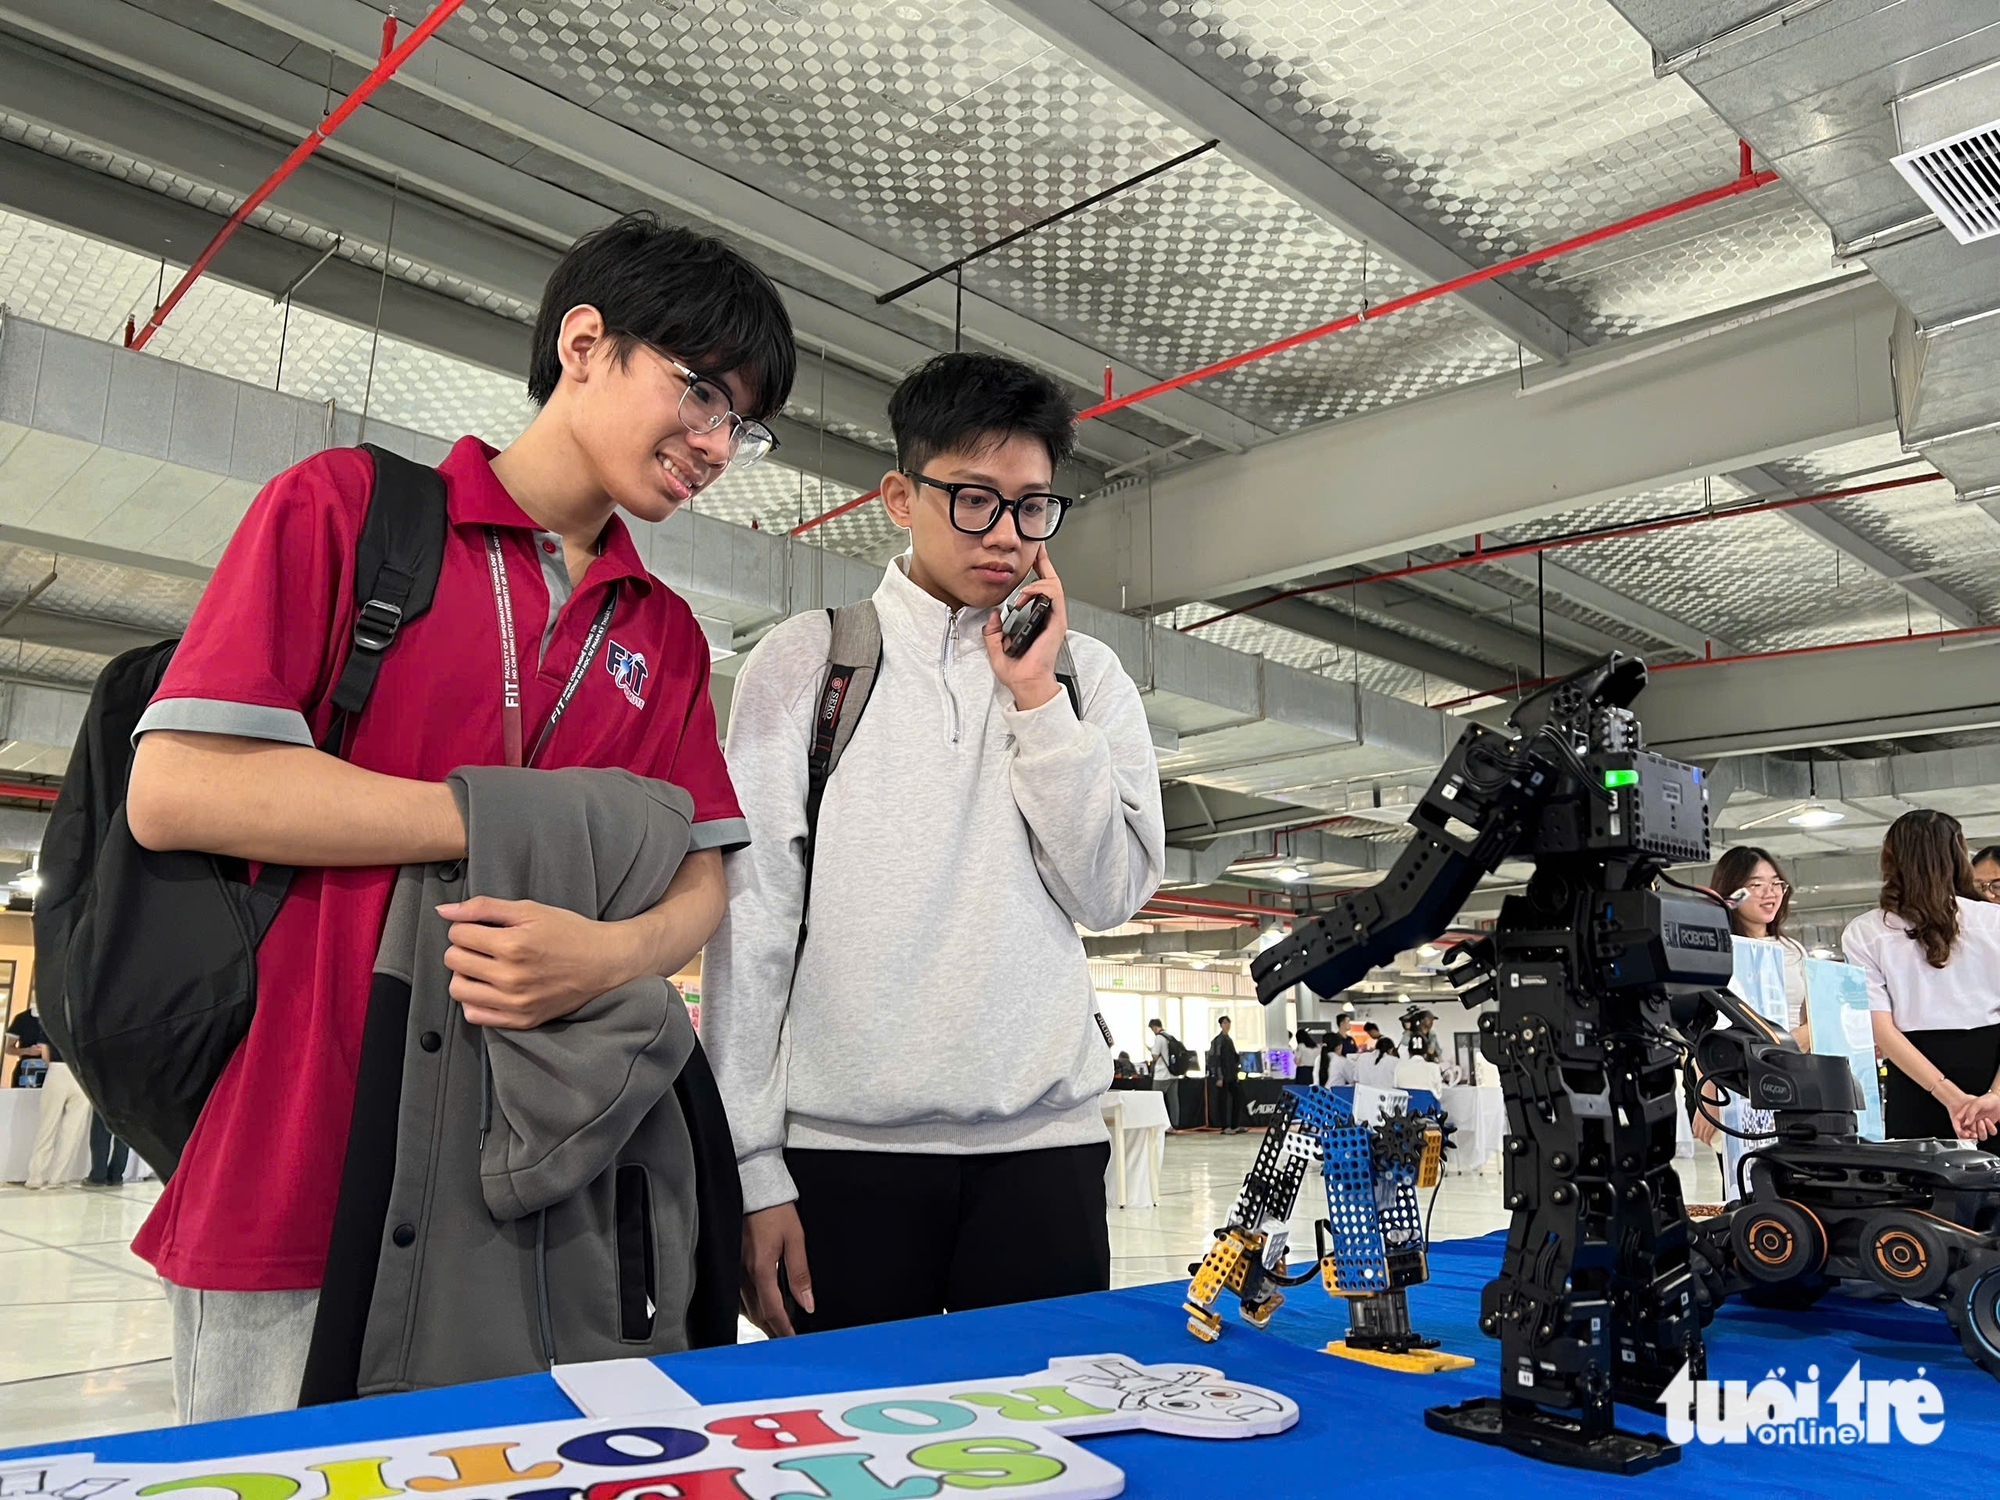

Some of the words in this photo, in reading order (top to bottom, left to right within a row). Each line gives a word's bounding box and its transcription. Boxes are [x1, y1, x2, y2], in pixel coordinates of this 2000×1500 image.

[493, 536, 505, 574] TECHNOLOGY
[490, 553, 501, 594] TECHNOLOGY
[501, 576, 507, 585] OF
[497, 595, 507, 639] INFORMATION
[502, 586, 513, 622] UNIVERSITY
[502, 640, 509, 649] OF
[606, 639, 648, 697] FIT
[505, 681, 519, 707] FIT
[551, 697, 565, 723] FIT
[1680, 929, 1717, 947] ROBOTIS
[1097, 1015, 1113, 1044] JULIDO
[470, 1436, 1067, 1500] STE
